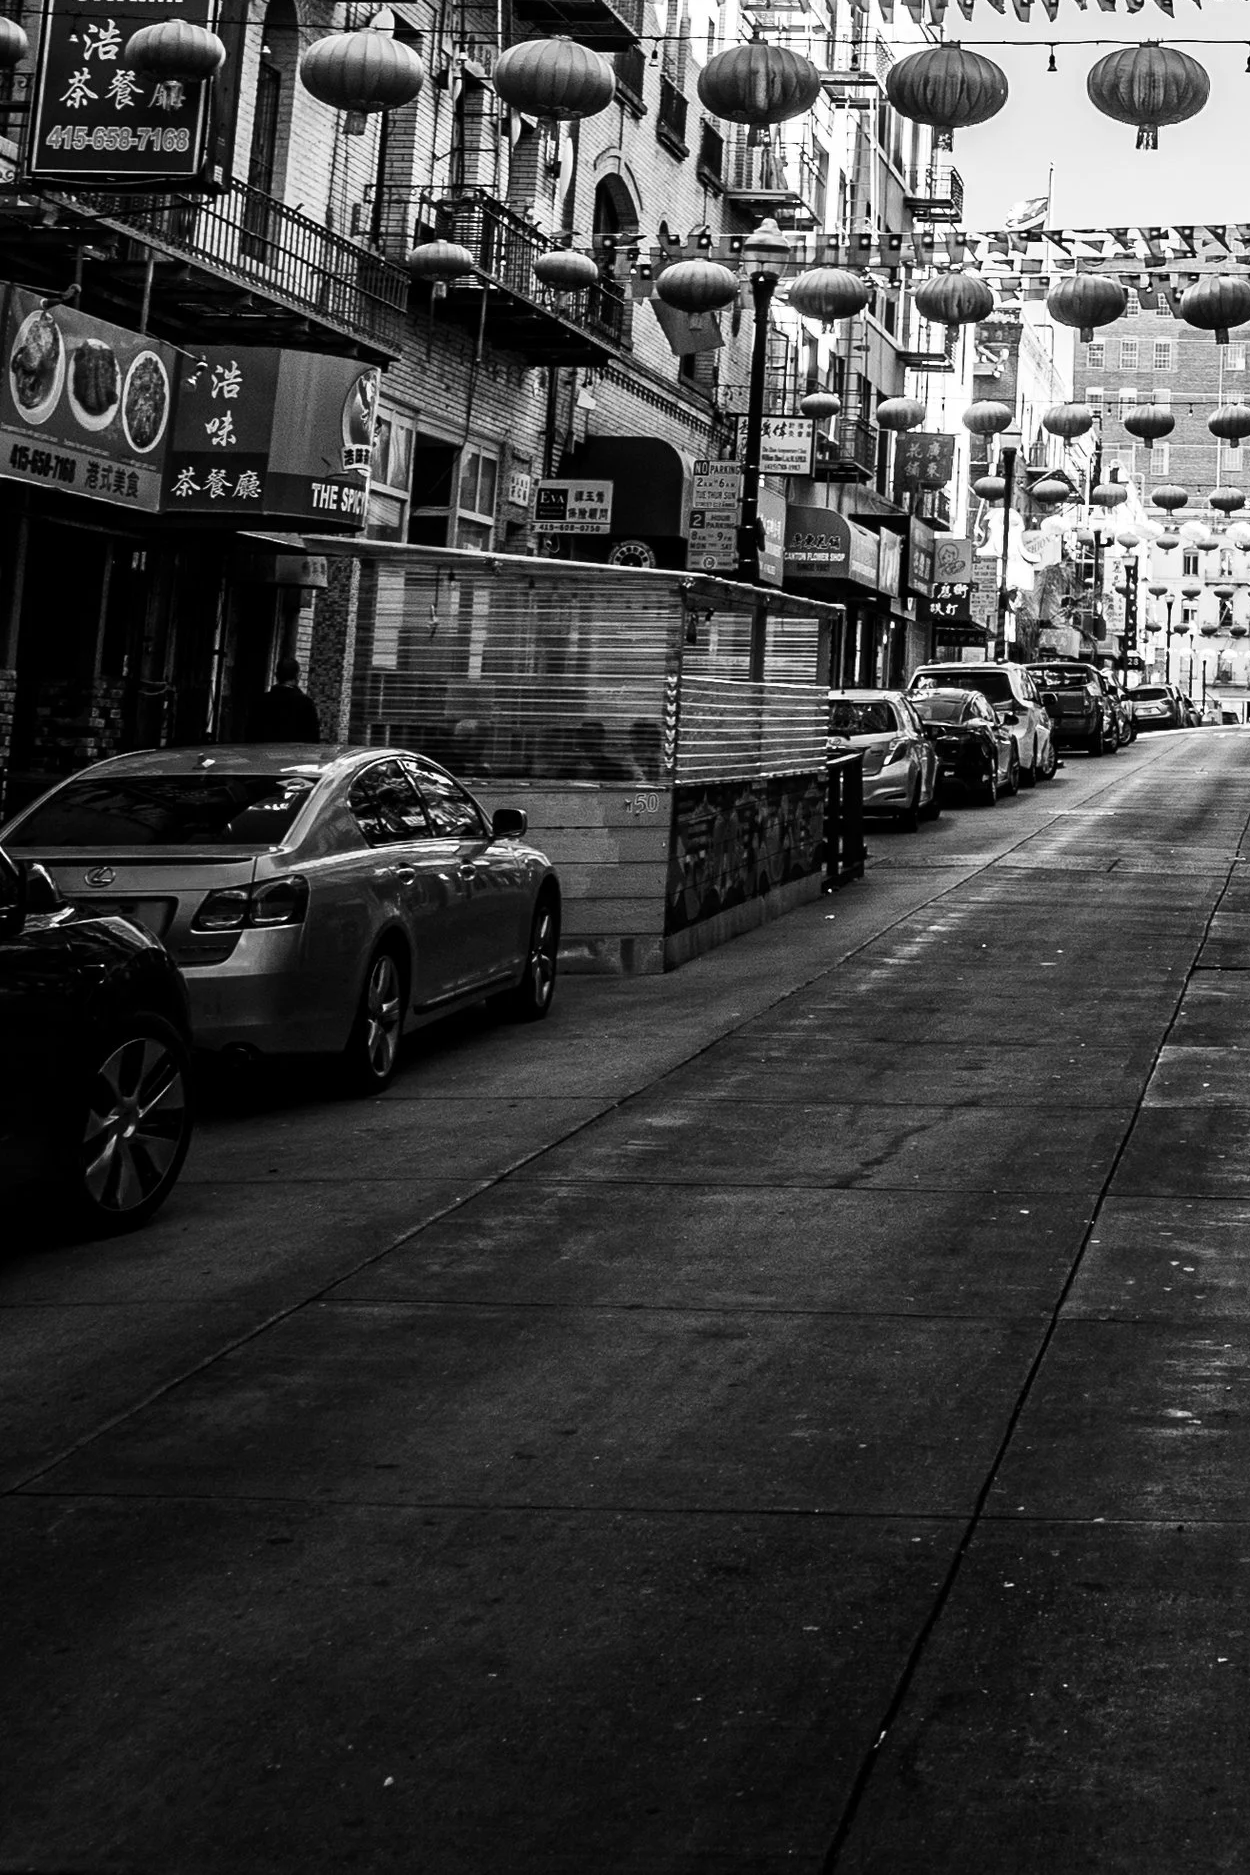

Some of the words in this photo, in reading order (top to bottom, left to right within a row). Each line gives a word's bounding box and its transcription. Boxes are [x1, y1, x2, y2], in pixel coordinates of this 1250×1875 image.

[46, 125, 190, 152] 415-658-7168
[694, 461, 708, 475] NO
[170, 467, 262, 500] 茶餐廳
[311, 482, 339, 510] THE
[693, 514, 703, 527] 2
[829, 552, 846, 562] SHOP
